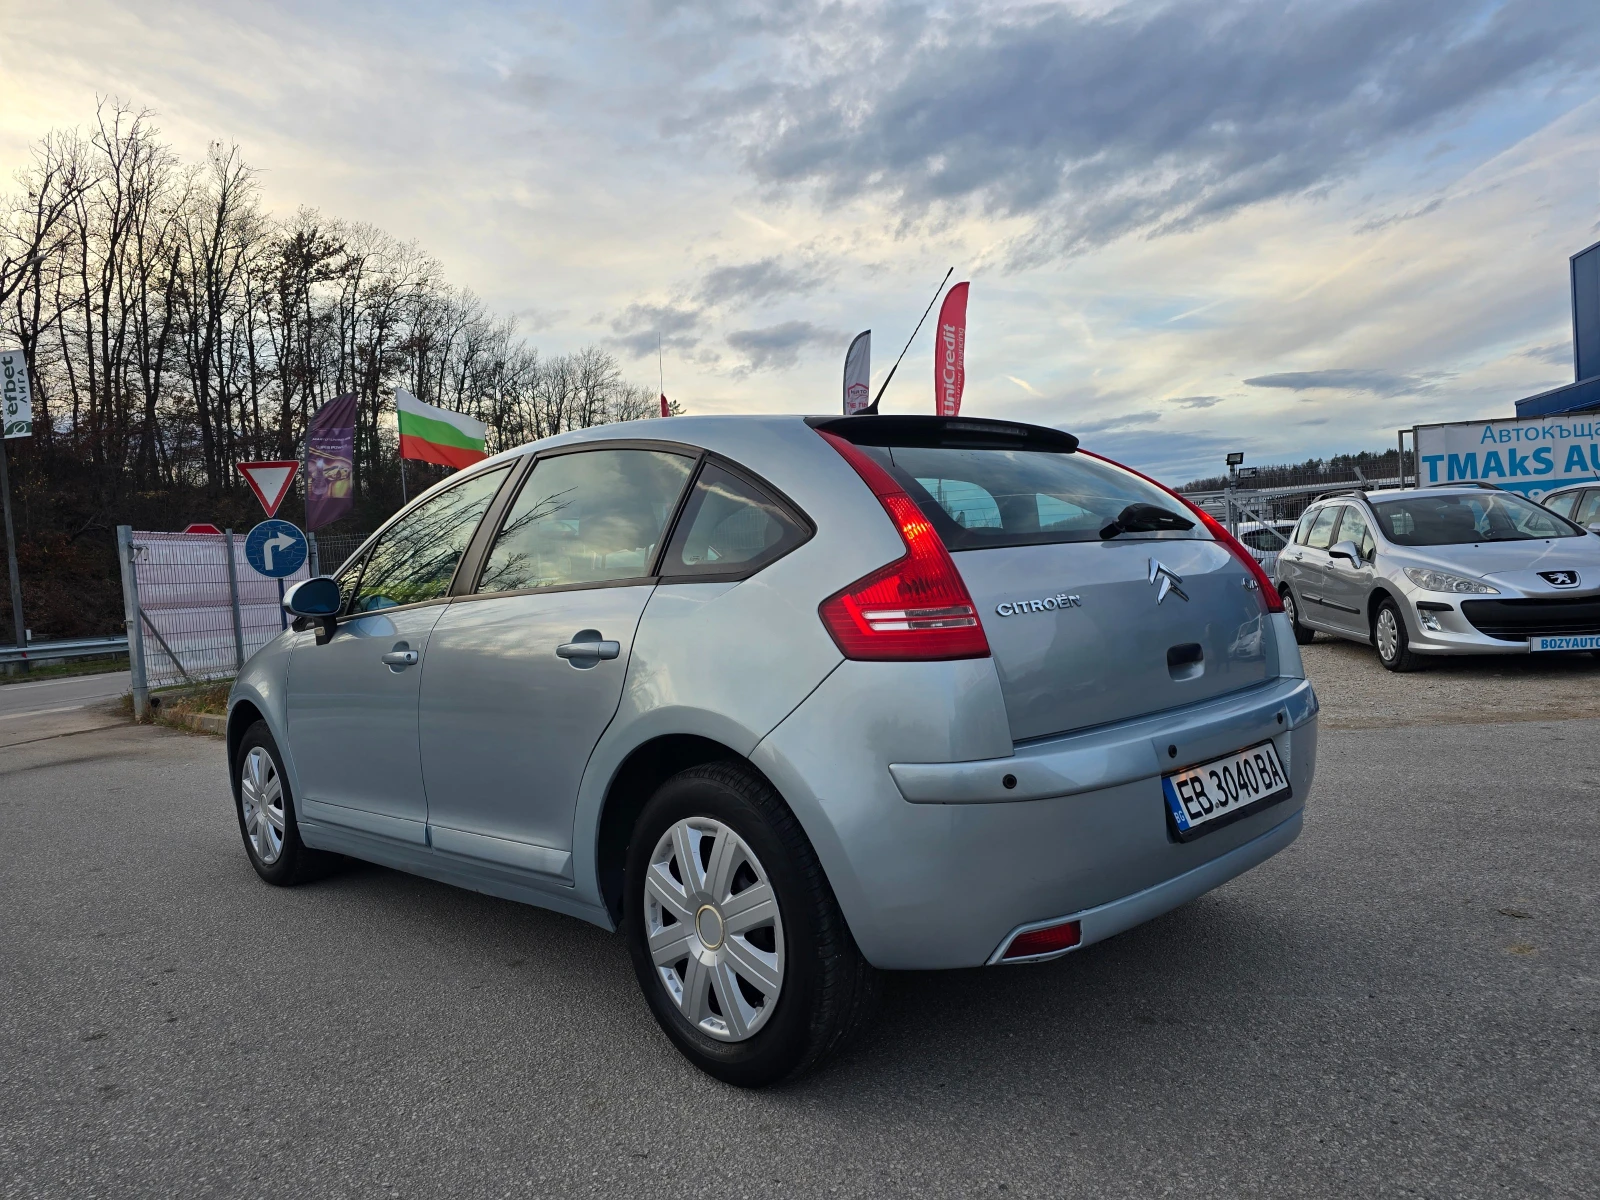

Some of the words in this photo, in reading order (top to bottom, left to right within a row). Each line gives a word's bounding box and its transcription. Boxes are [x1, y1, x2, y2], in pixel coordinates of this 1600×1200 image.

[1, 355, 18, 415] efbet
[17, 368, 28, 404] ЛИГА
[943, 323, 956, 416] UniCredit
[1421, 446, 1555, 483] TMAkS
[995, 593, 1082, 617] CITROËN
[1173, 810, 1186, 824] BG
